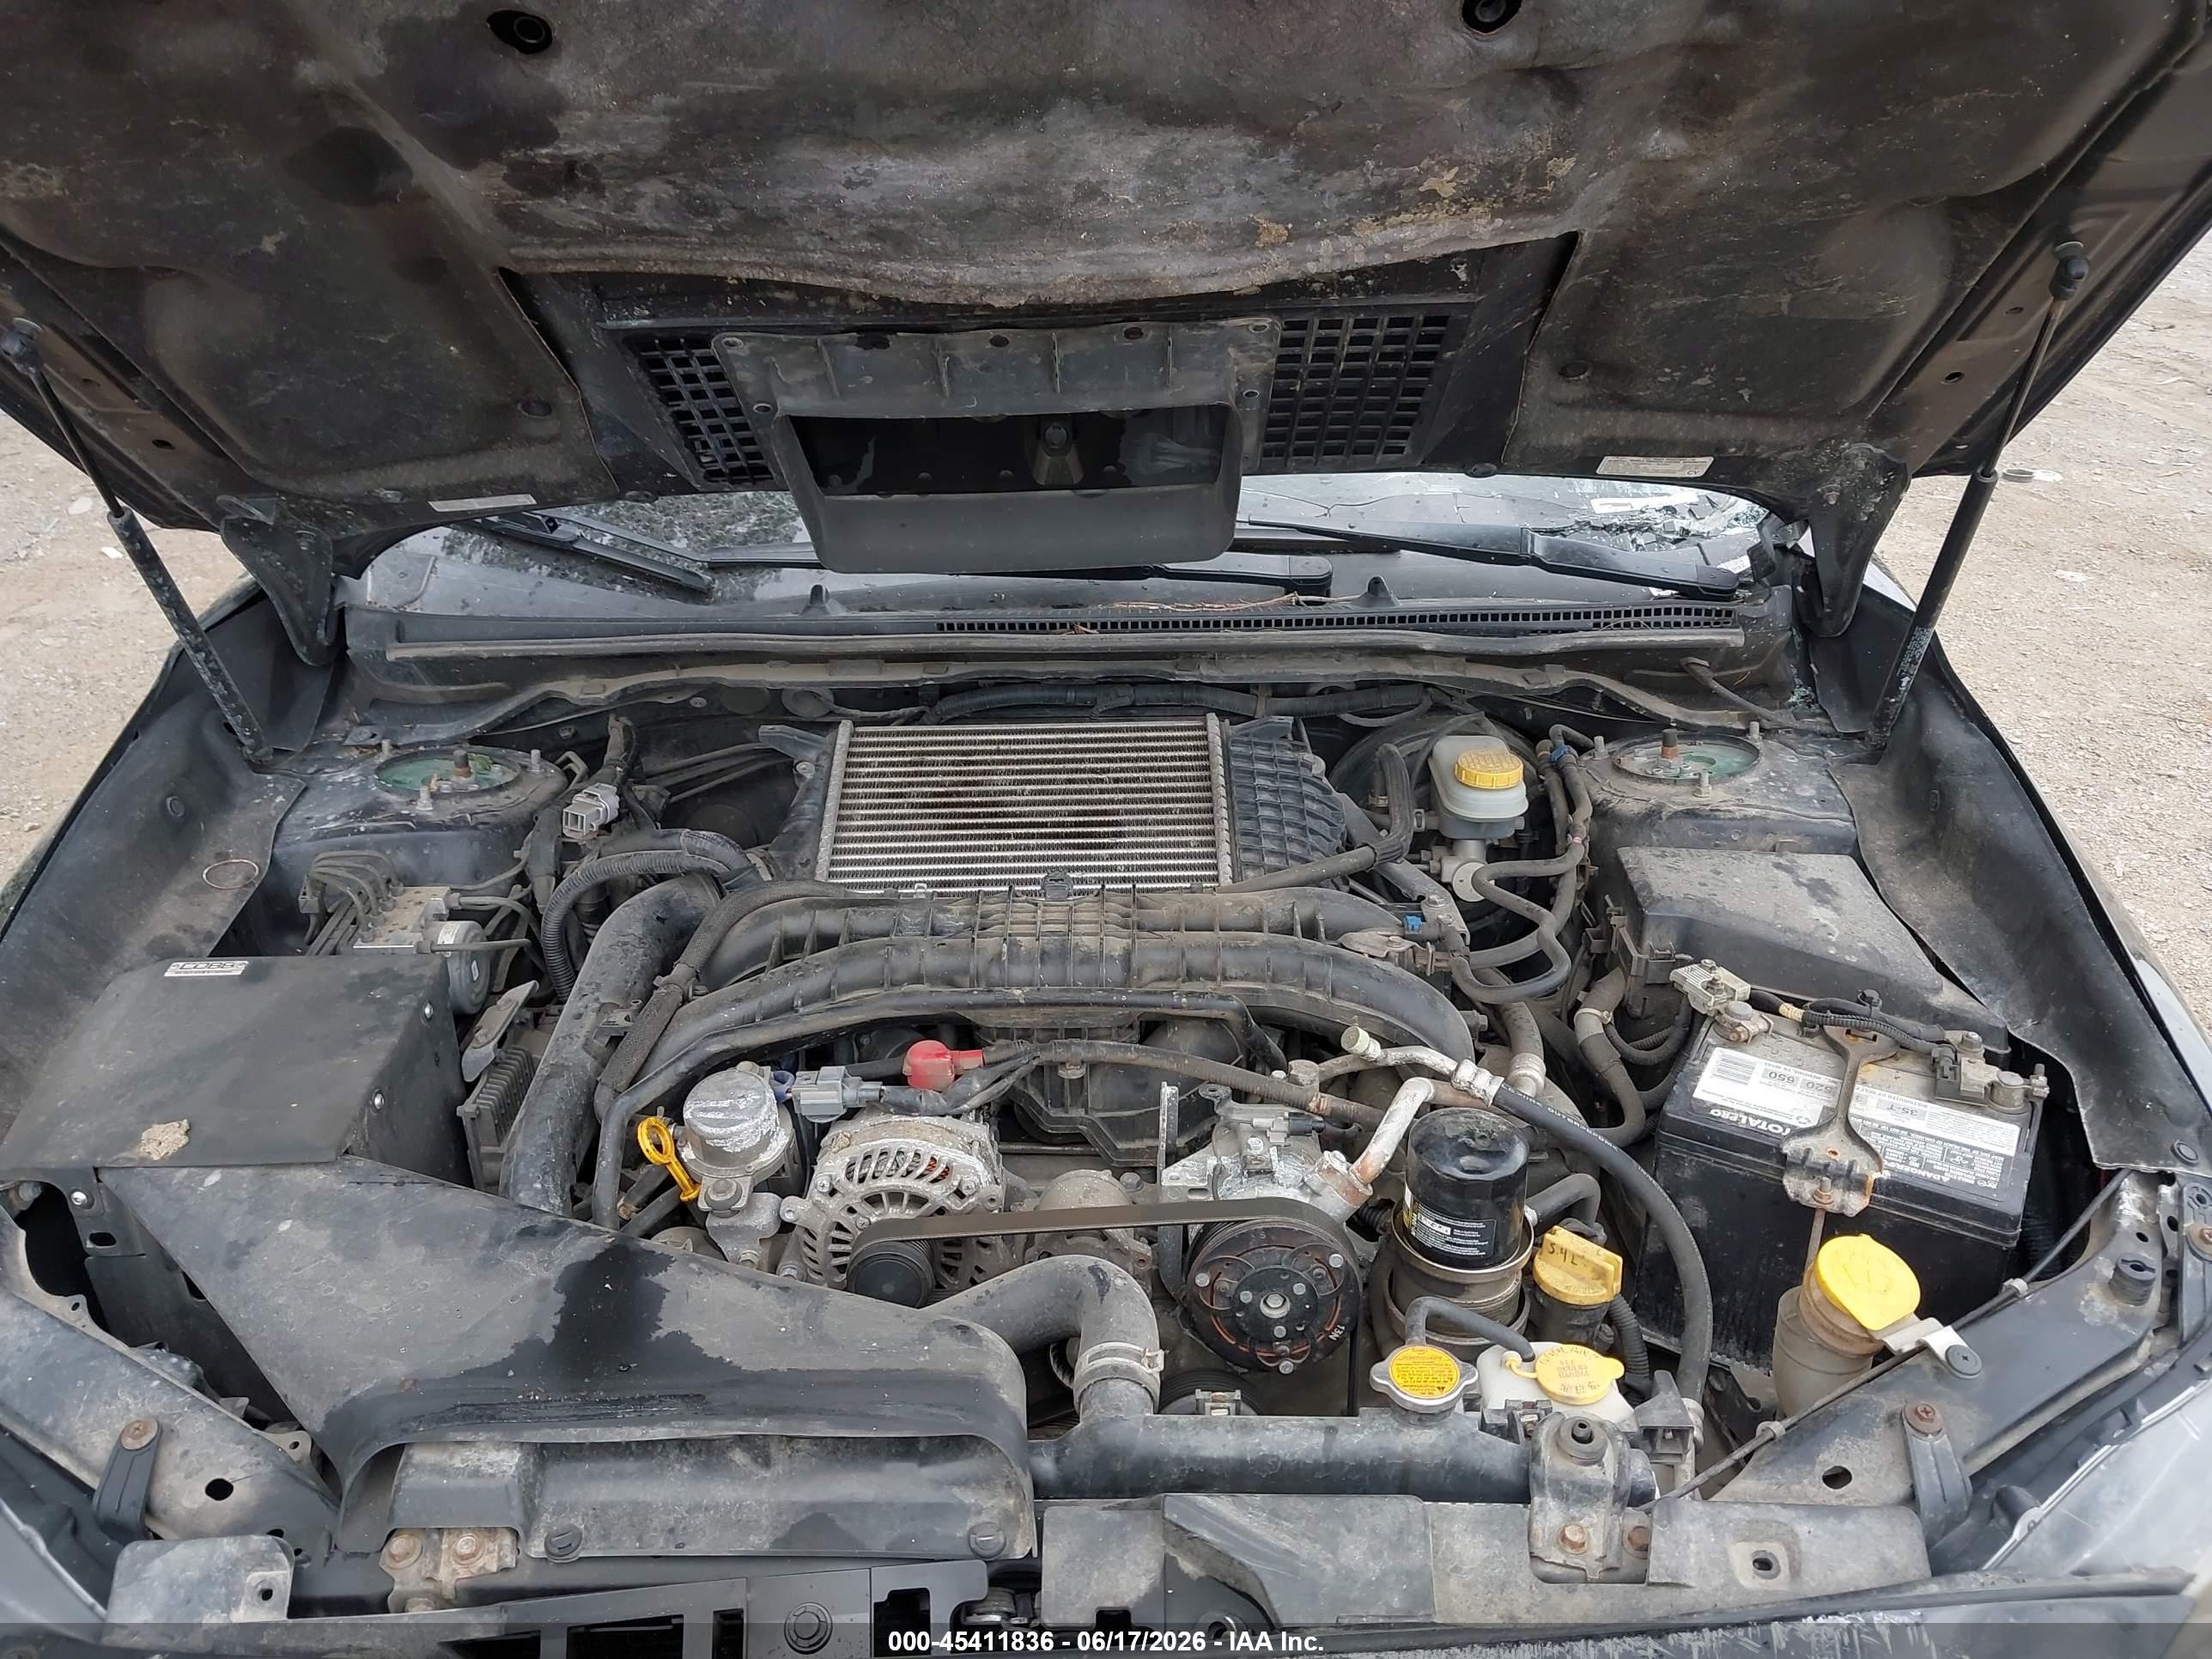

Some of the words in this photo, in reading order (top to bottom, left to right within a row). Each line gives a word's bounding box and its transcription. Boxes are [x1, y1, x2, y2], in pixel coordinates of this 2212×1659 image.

[1768, 1070, 1796, 1085] 650
[1806, 1080, 1834, 1095] 520
[1887, 1103, 1918, 1116] 35-T
